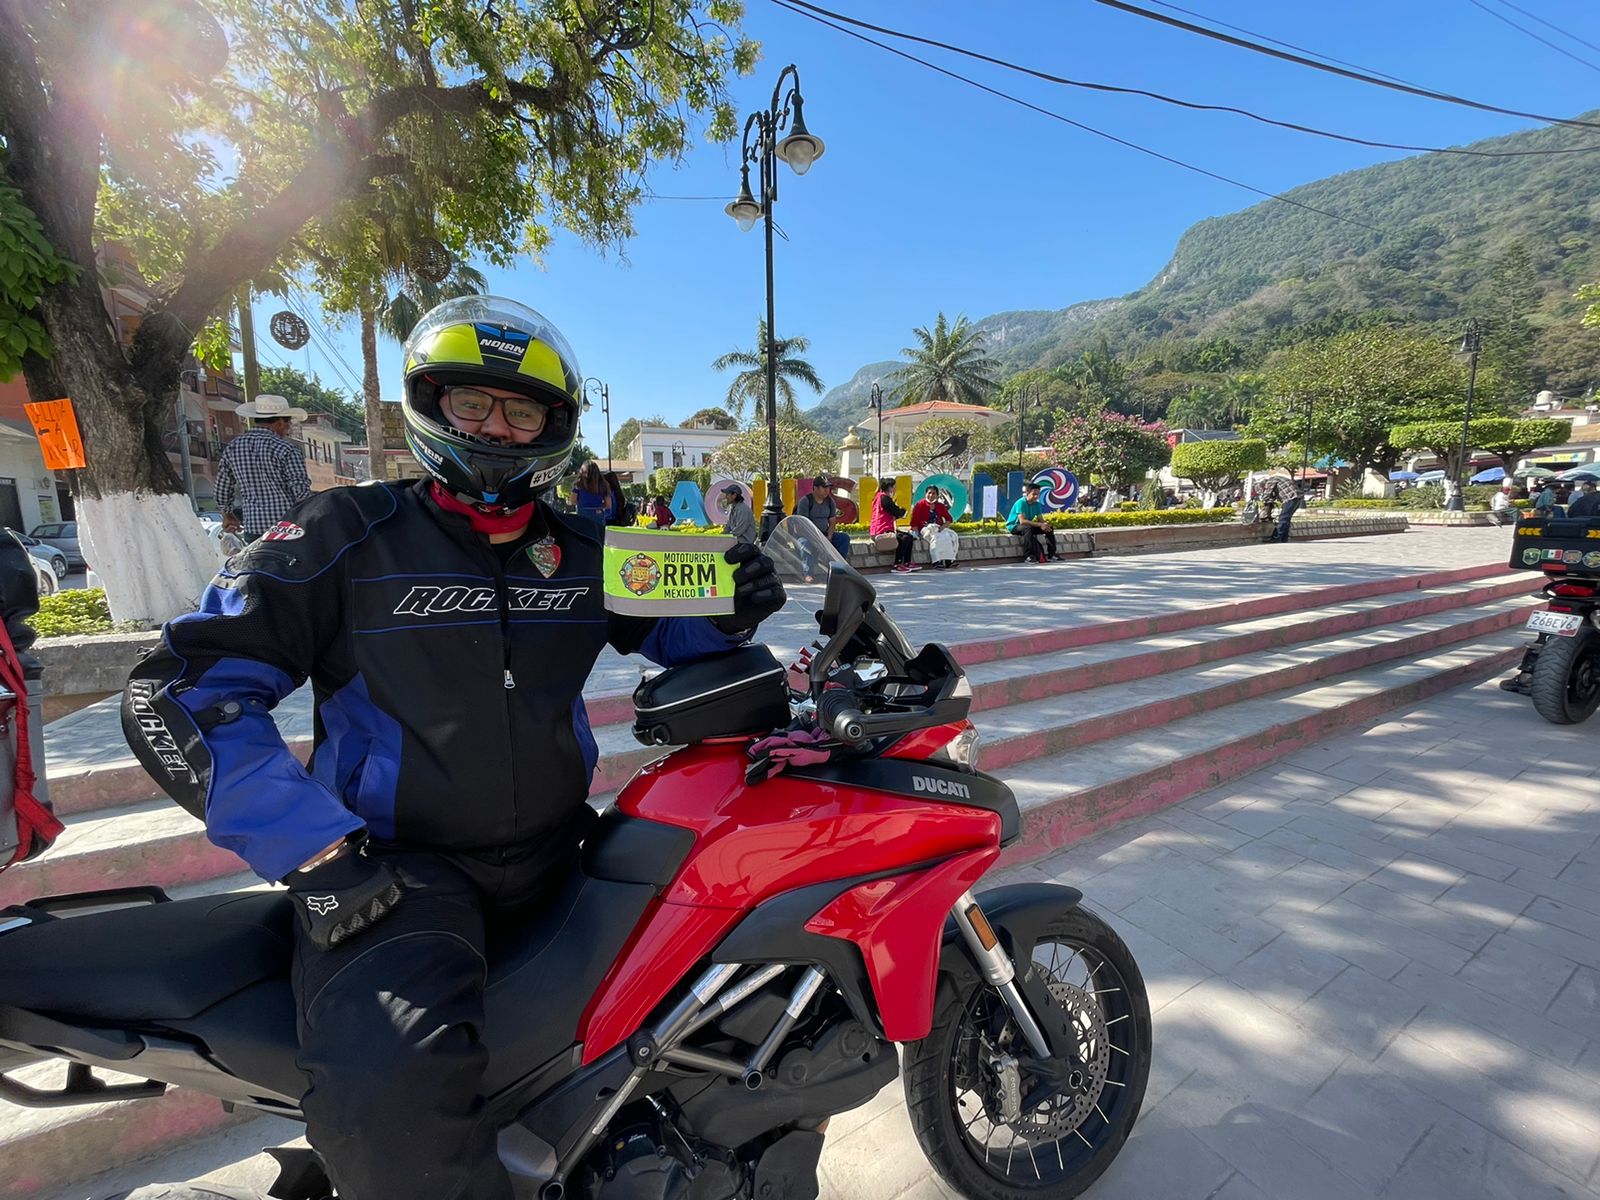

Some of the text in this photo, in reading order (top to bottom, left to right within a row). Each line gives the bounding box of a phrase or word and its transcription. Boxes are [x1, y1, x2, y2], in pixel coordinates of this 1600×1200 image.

[480, 339, 525, 355] NOLAN
[664, 553, 716, 563] MOTOTURISTA
[663, 564, 717, 586] RRM
[393, 586, 589, 616] ROCKET
[912, 776, 970, 799] DUCATI
